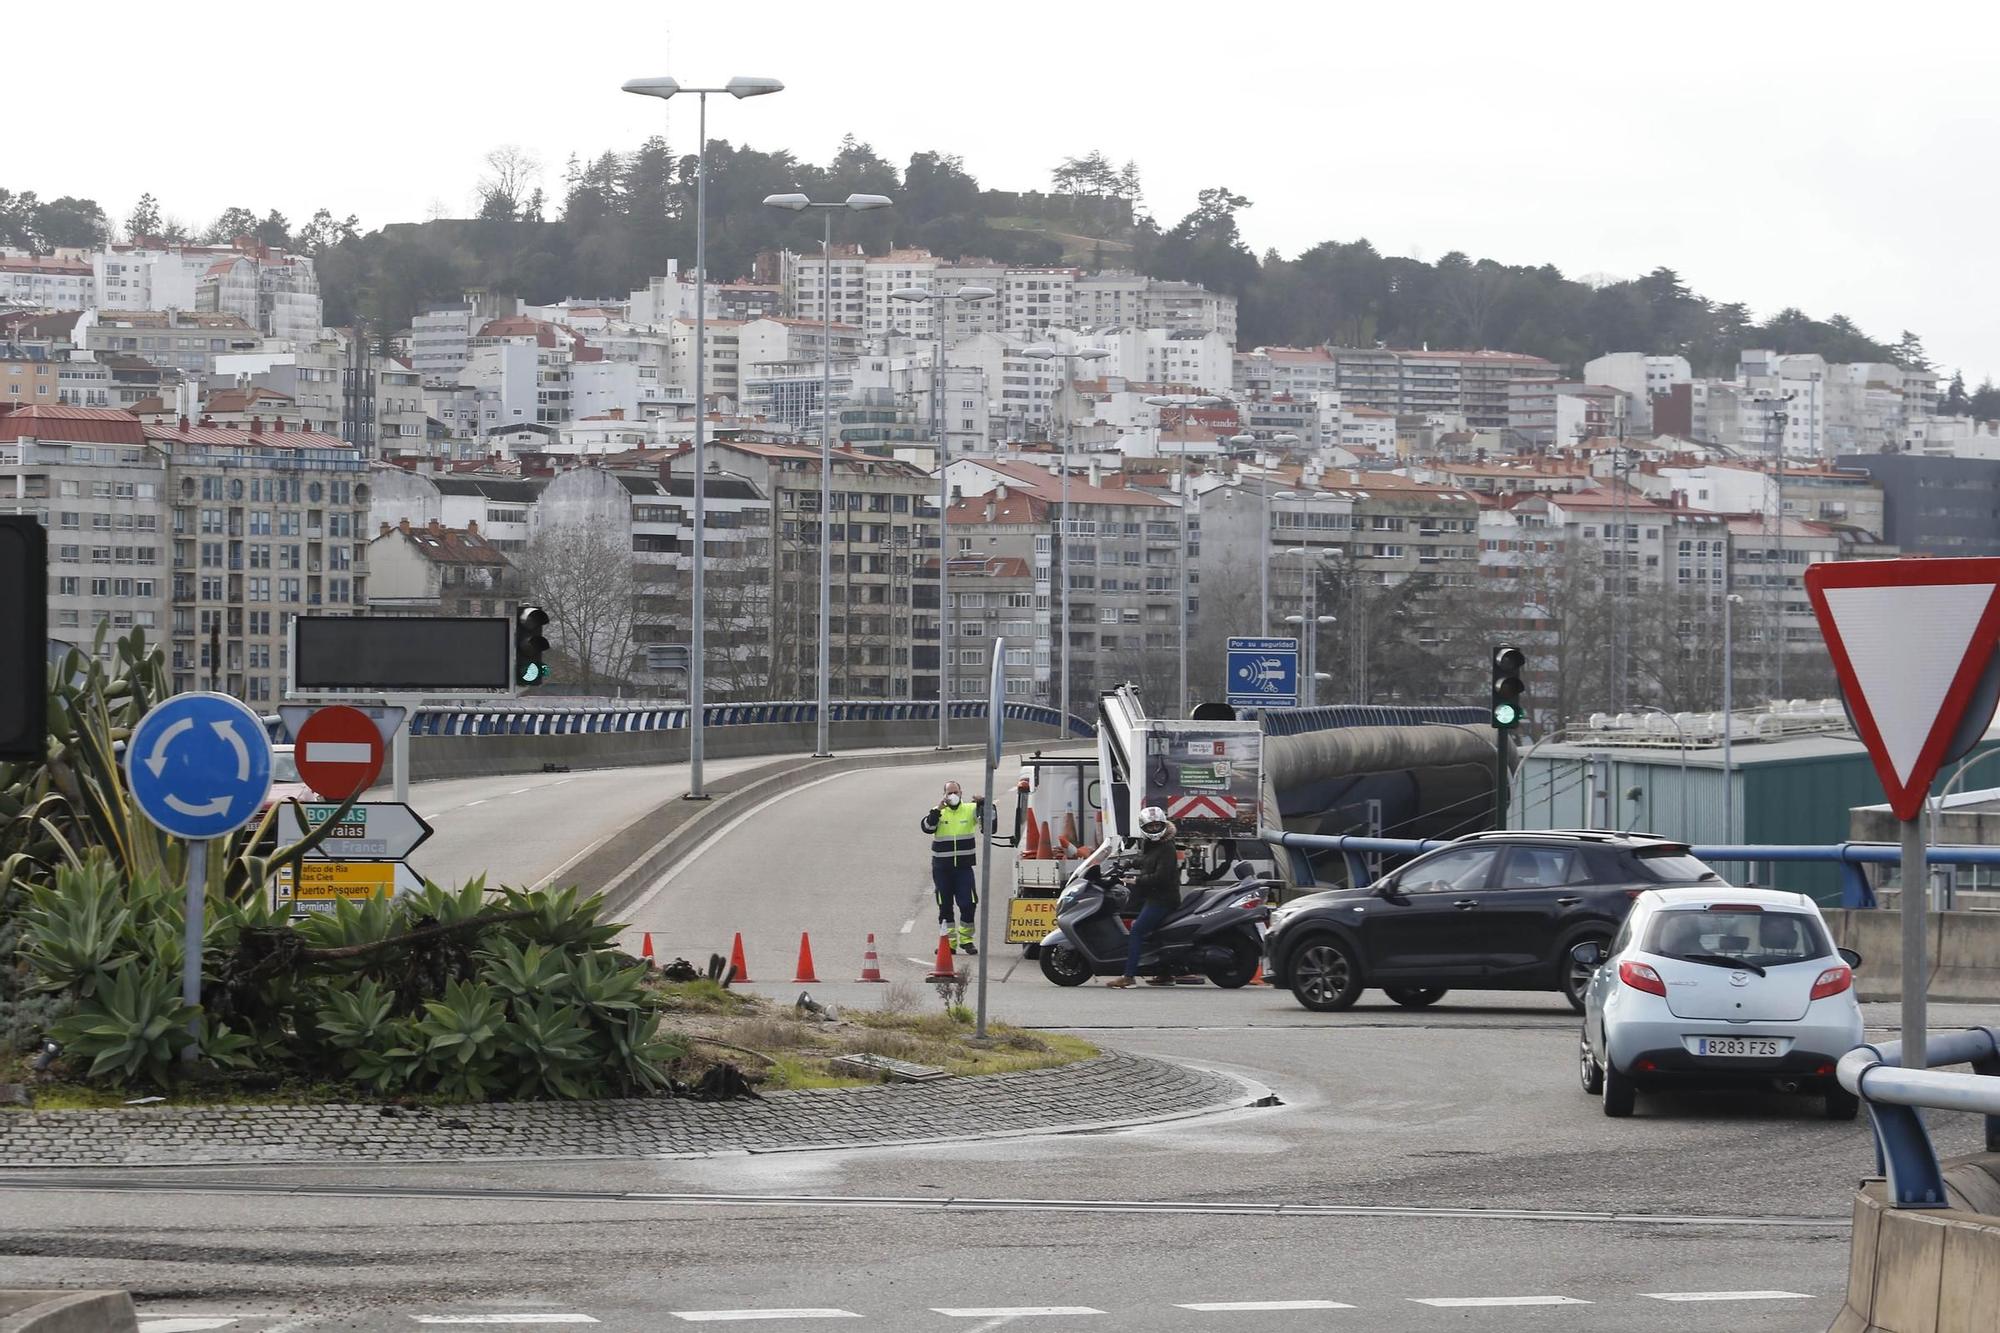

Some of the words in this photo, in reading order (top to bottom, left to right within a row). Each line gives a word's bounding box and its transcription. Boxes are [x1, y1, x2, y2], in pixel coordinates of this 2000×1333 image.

[1199, 417, 1238, 428] Satander
[1260, 640, 1294, 648] seguridad
[307, 809, 366, 821] BOAS
[328, 824, 364, 837] raias
[1708, 1040, 1745, 1054] 8283
[1749, 1041, 1777, 1055] FZS
